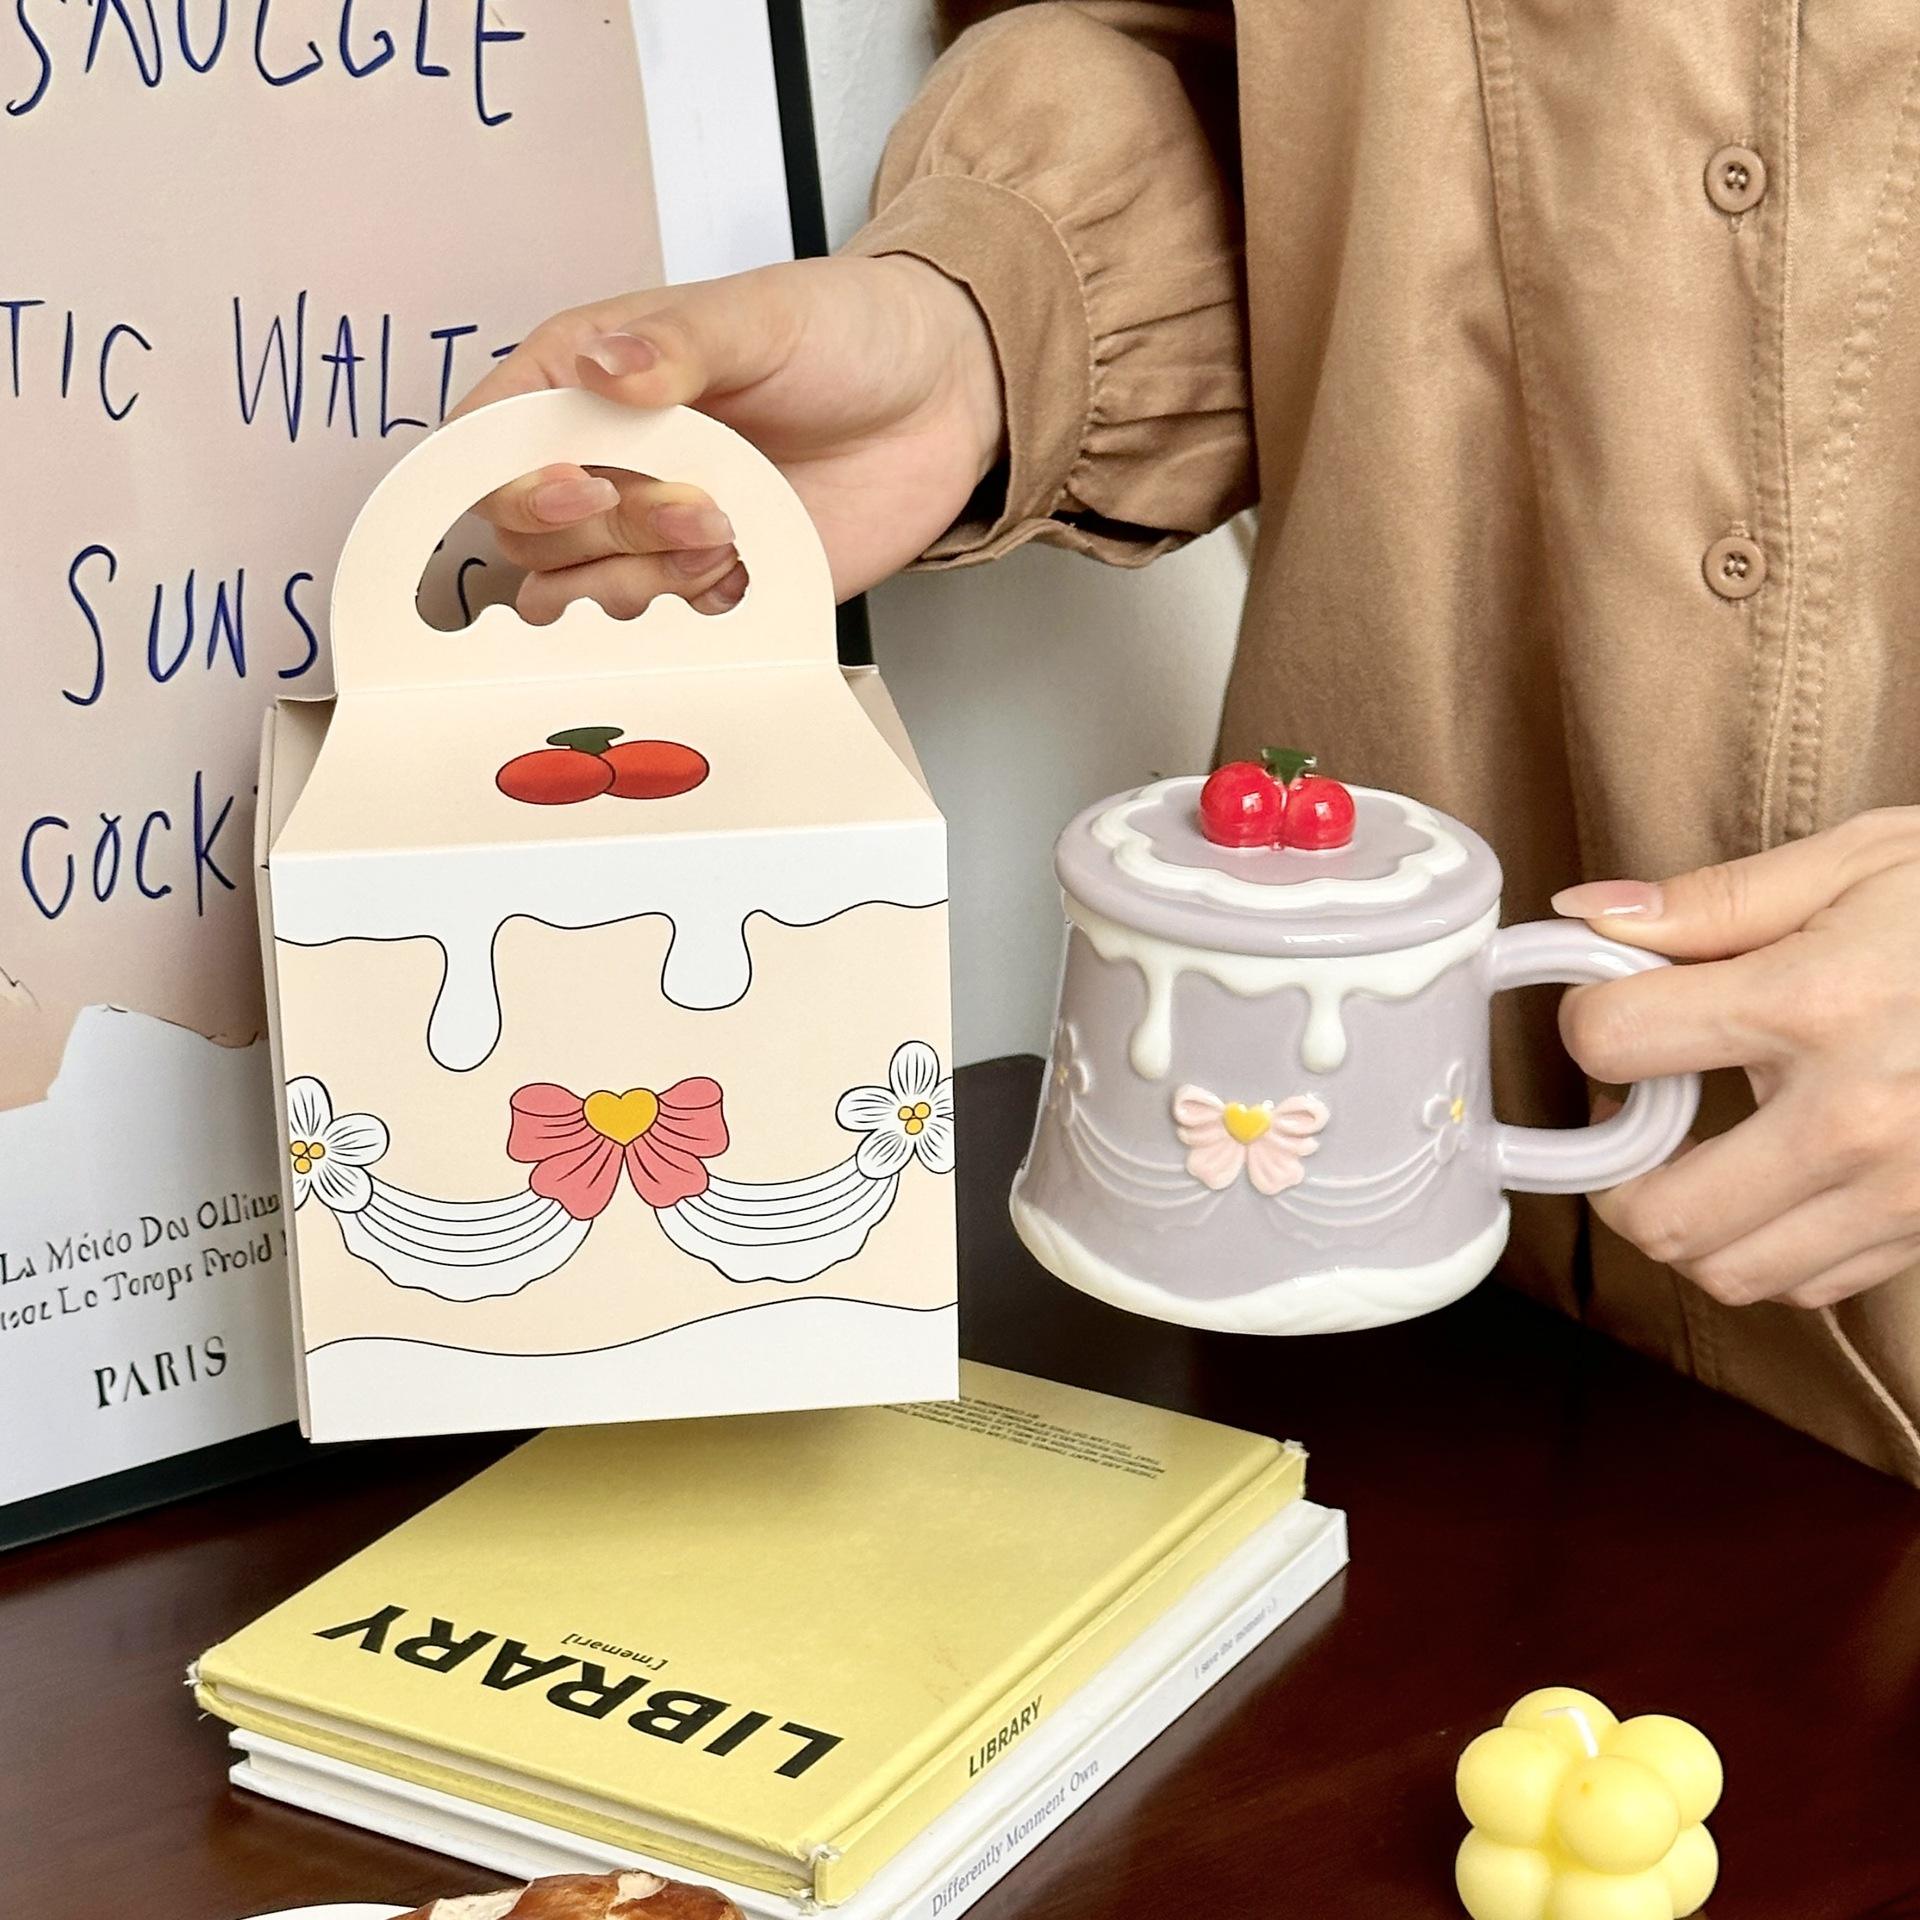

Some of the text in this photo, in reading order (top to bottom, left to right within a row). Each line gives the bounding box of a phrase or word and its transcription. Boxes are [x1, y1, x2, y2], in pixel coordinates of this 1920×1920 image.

[232, 289, 521, 443] WALT
[21, 770, 259, 919] COCK
[93, 1335, 227, 1409] PARIS
[312, 1604, 844, 1779] LIBRARY
[968, 1694, 1042, 1778] LIBRARY
[932, 1759, 1100, 1917] Differently Monment Own
